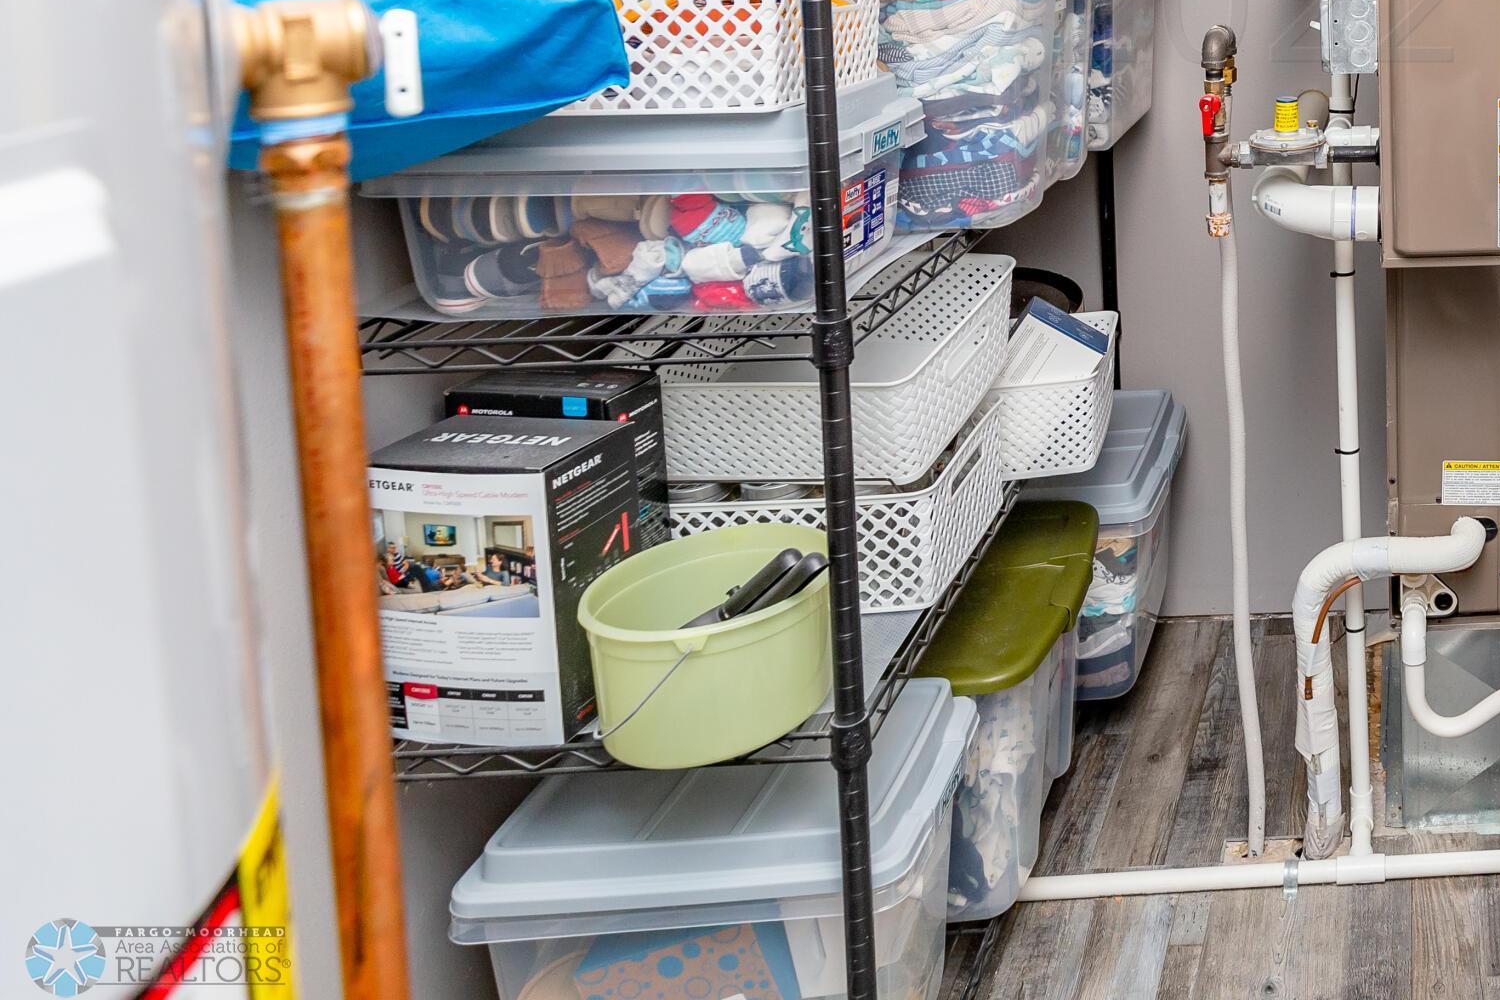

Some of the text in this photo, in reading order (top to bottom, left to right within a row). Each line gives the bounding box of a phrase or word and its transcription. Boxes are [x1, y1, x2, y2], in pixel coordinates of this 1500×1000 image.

[873, 129, 900, 152] Hefty
[471, 408, 513, 416] MOTOROLA
[430, 432, 573, 447] NETGEAR
[552, 454, 603, 489] NETGEAR
[369, 479, 413, 492] ETGEAR
